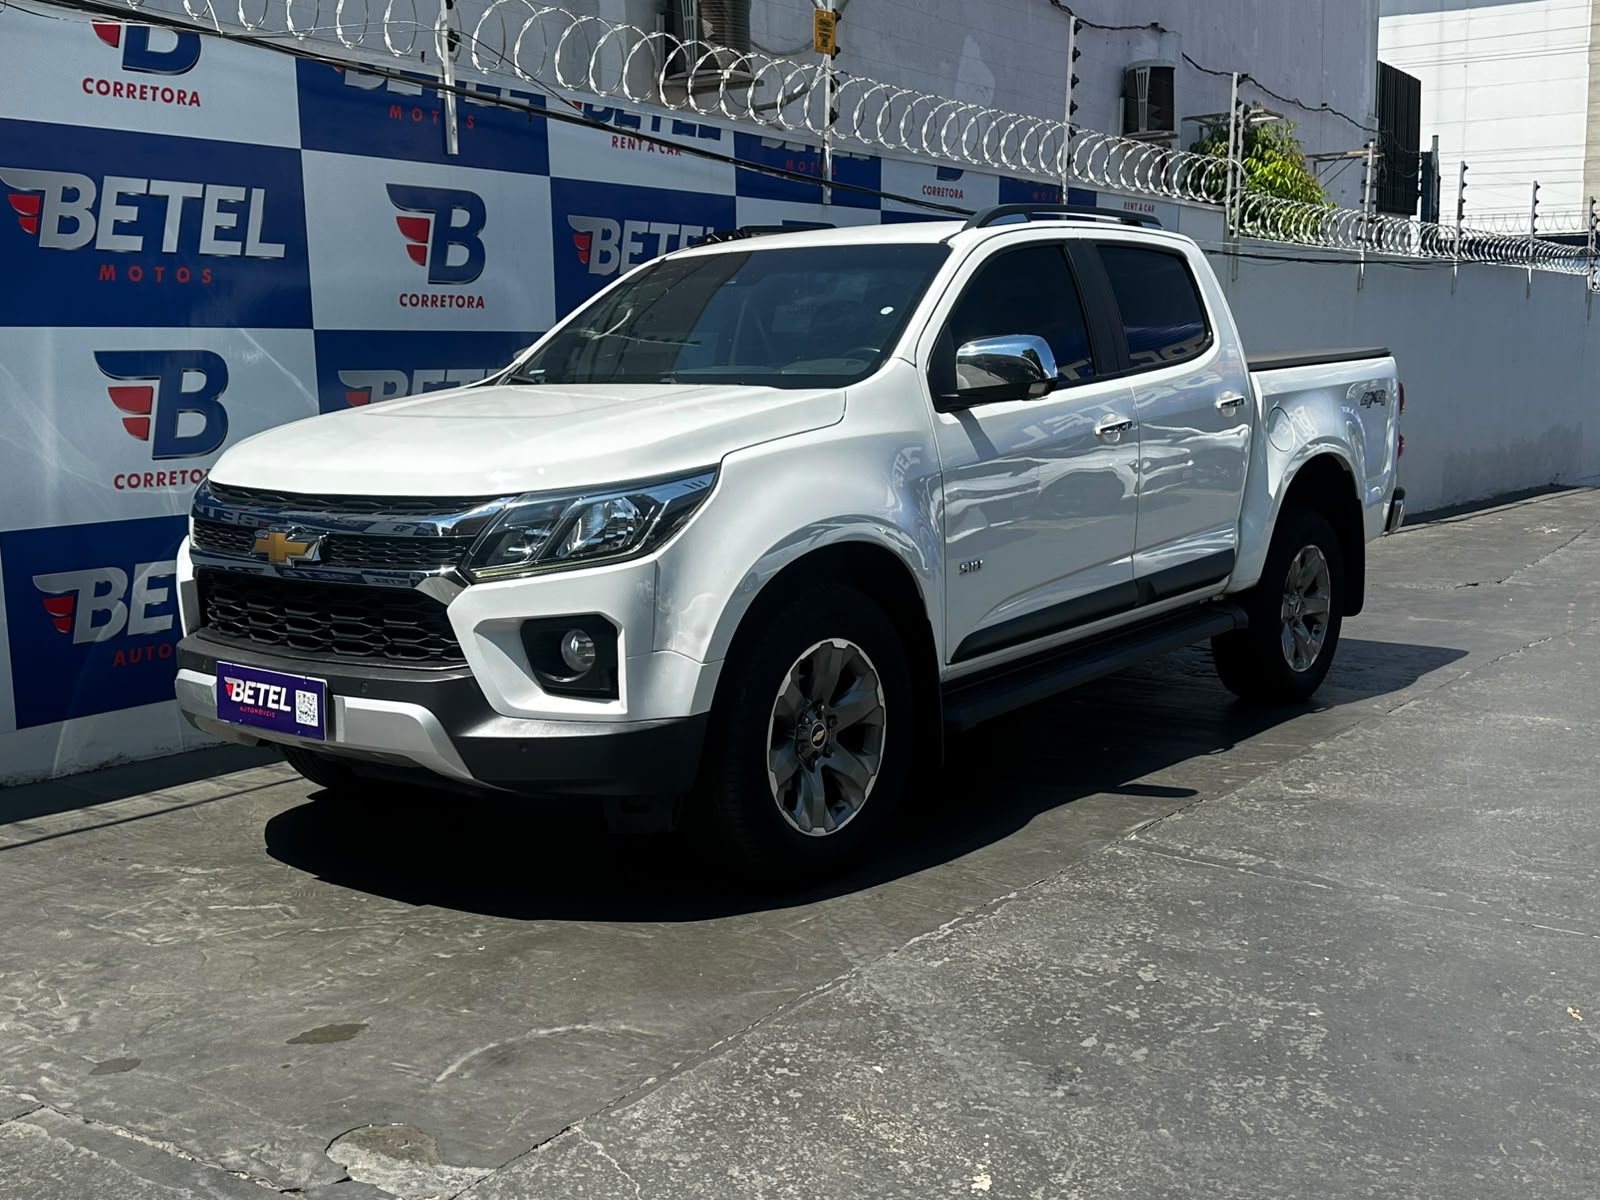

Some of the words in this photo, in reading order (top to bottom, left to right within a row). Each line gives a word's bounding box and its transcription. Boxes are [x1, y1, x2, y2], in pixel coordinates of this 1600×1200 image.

[82, 77, 202, 107] CORRETORA
[389, 105, 475, 129] MOTS
[612, 134, 644, 151] RENT
[647, 141, 655, 153] A
[921, 184, 964, 199] CORRETORA
[0, 167, 286, 258] BETEL
[99, 264, 213, 284] MOTOS
[399, 293, 485, 309] CORRETORA
[113, 643, 173, 668] AUTO
[224, 676, 291, 713] BETEL
